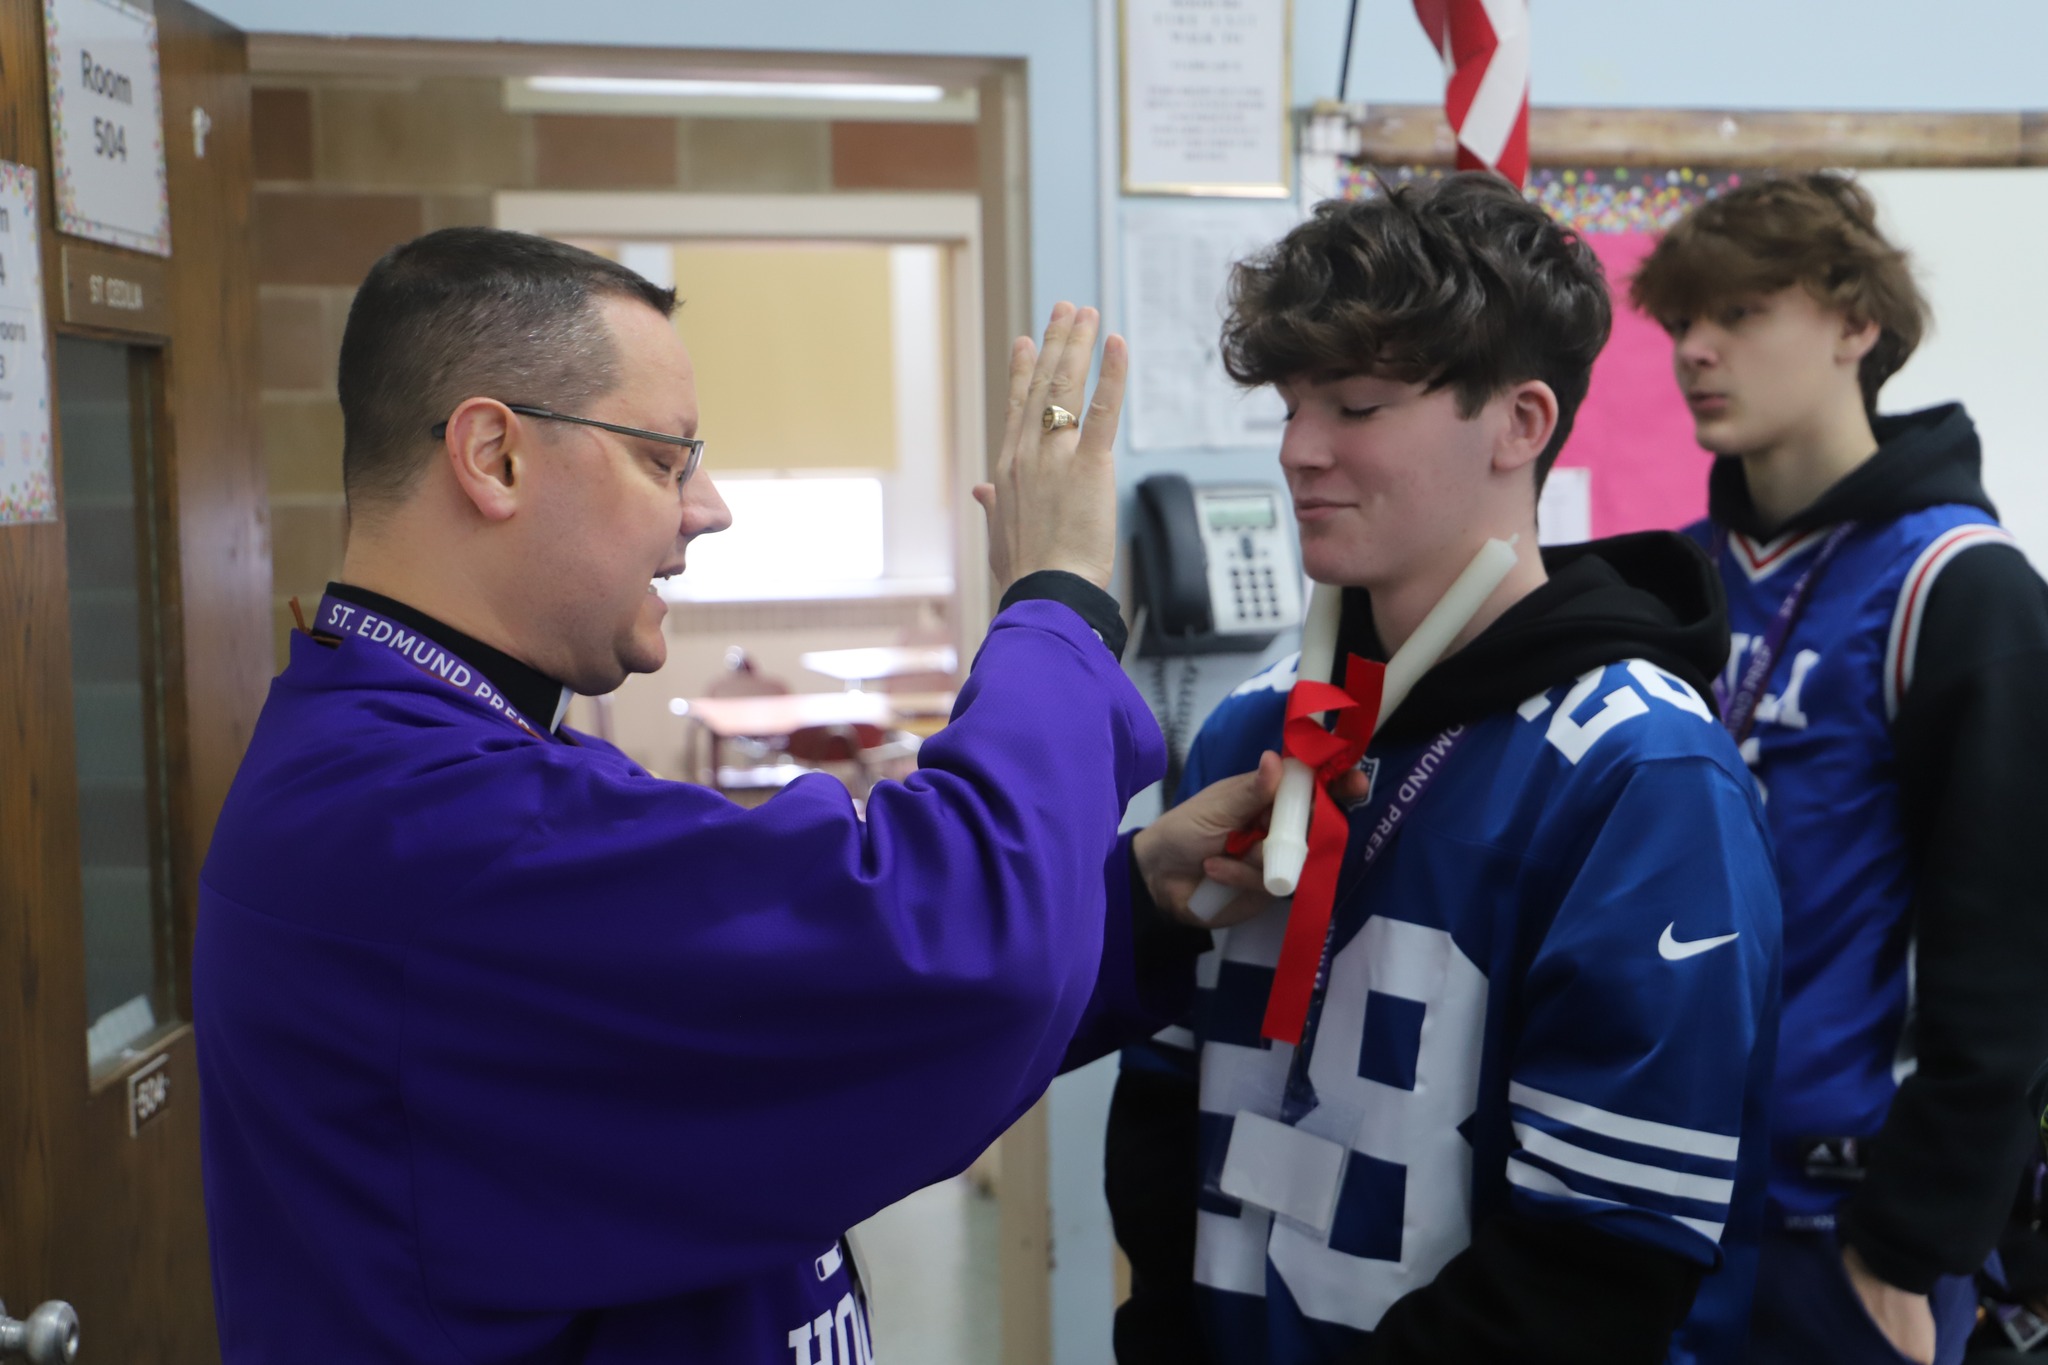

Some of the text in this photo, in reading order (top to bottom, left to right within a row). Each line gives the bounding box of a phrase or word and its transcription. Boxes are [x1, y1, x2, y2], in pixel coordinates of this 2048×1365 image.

[81, 49, 132, 105] Room
[94, 116, 127, 162] 504
[327, 603, 356, 632] ST.
[357, 615, 472, 688] EDMUND
[1364, 804, 1402, 861] PREP
